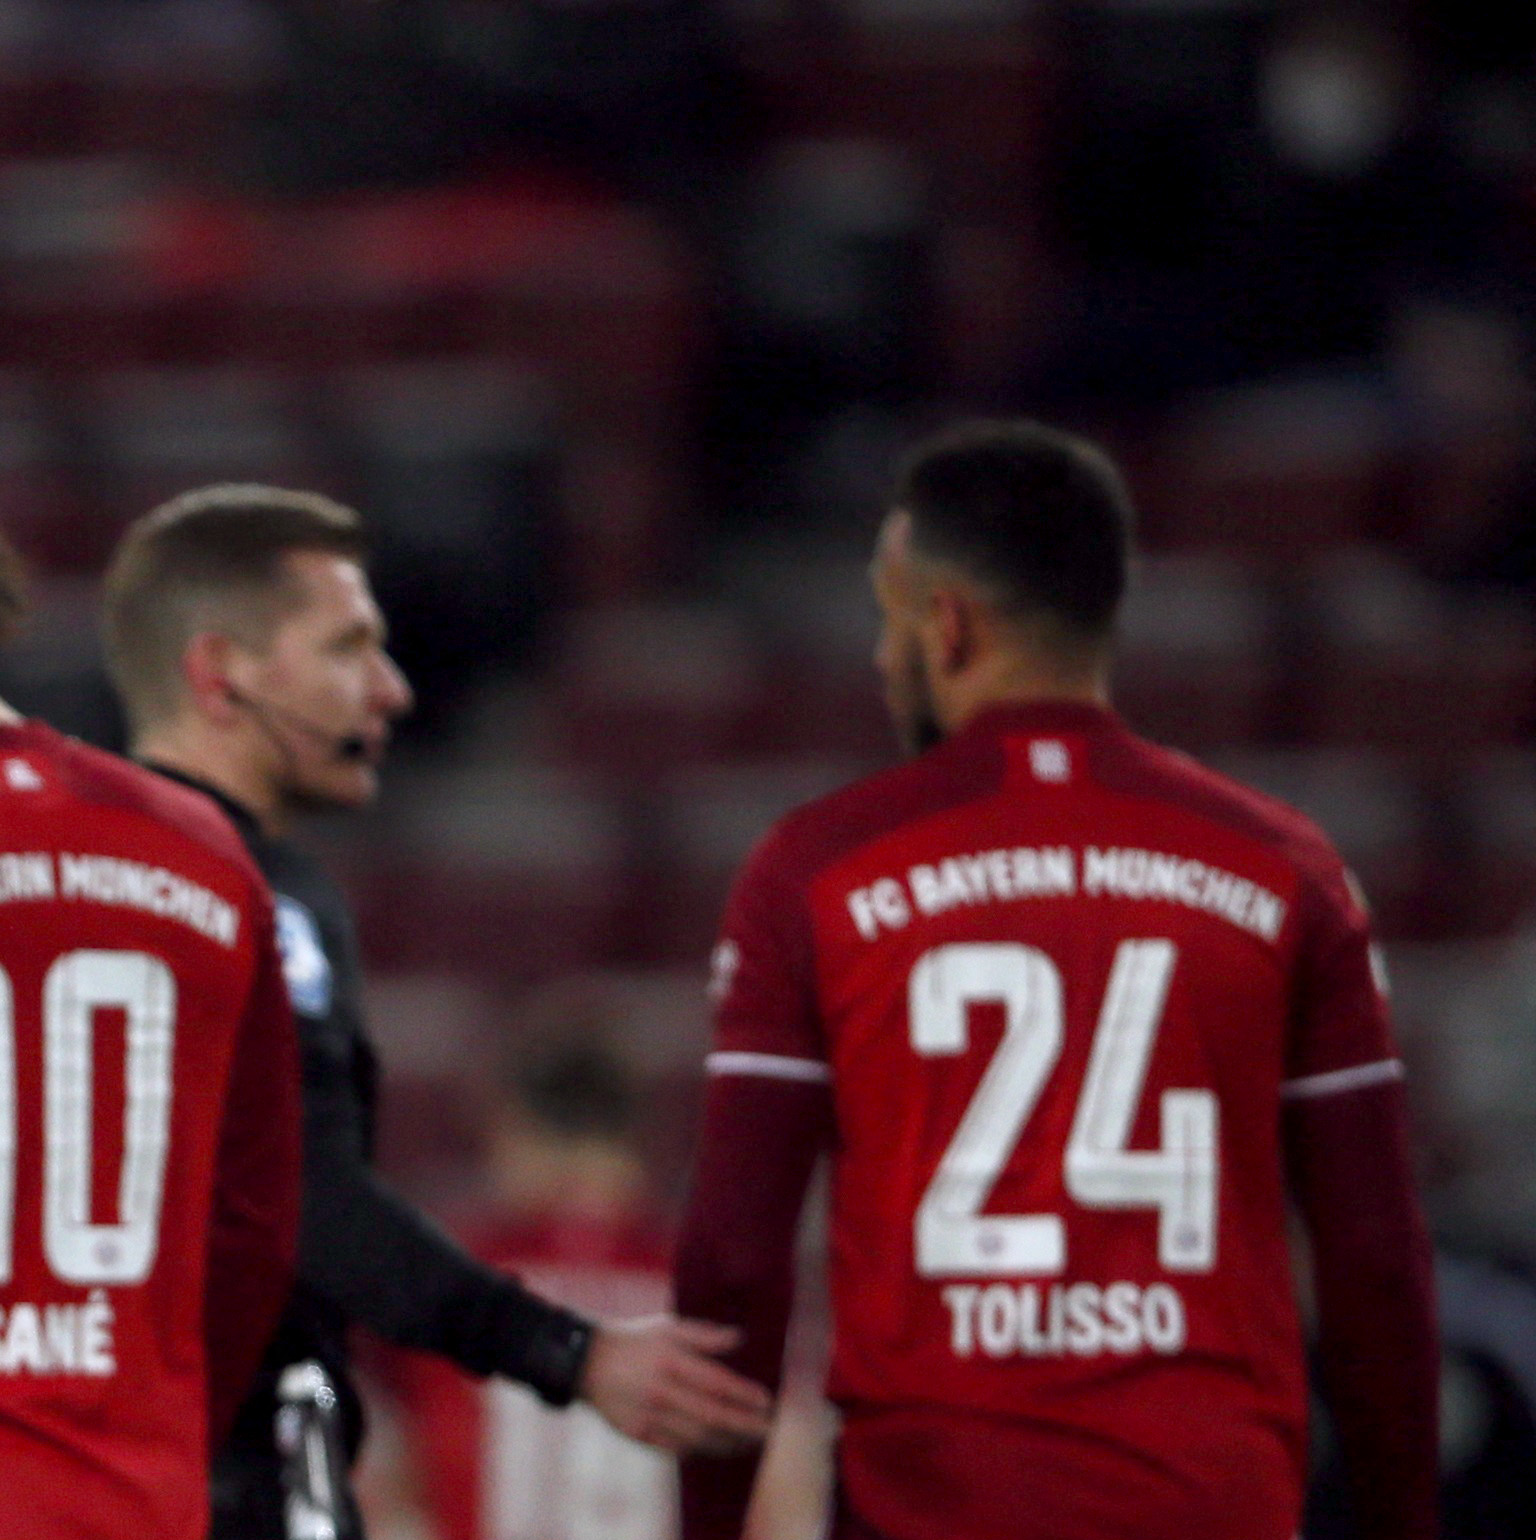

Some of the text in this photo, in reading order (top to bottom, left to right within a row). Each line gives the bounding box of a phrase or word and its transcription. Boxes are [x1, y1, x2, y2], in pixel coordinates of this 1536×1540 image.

[846, 877, 911, 941] FC
[908, 846, 1076, 916] BAYERN
[909, 939, 1218, 1276] 24
[942, 1281, 1187, 1358] TOLISSO
